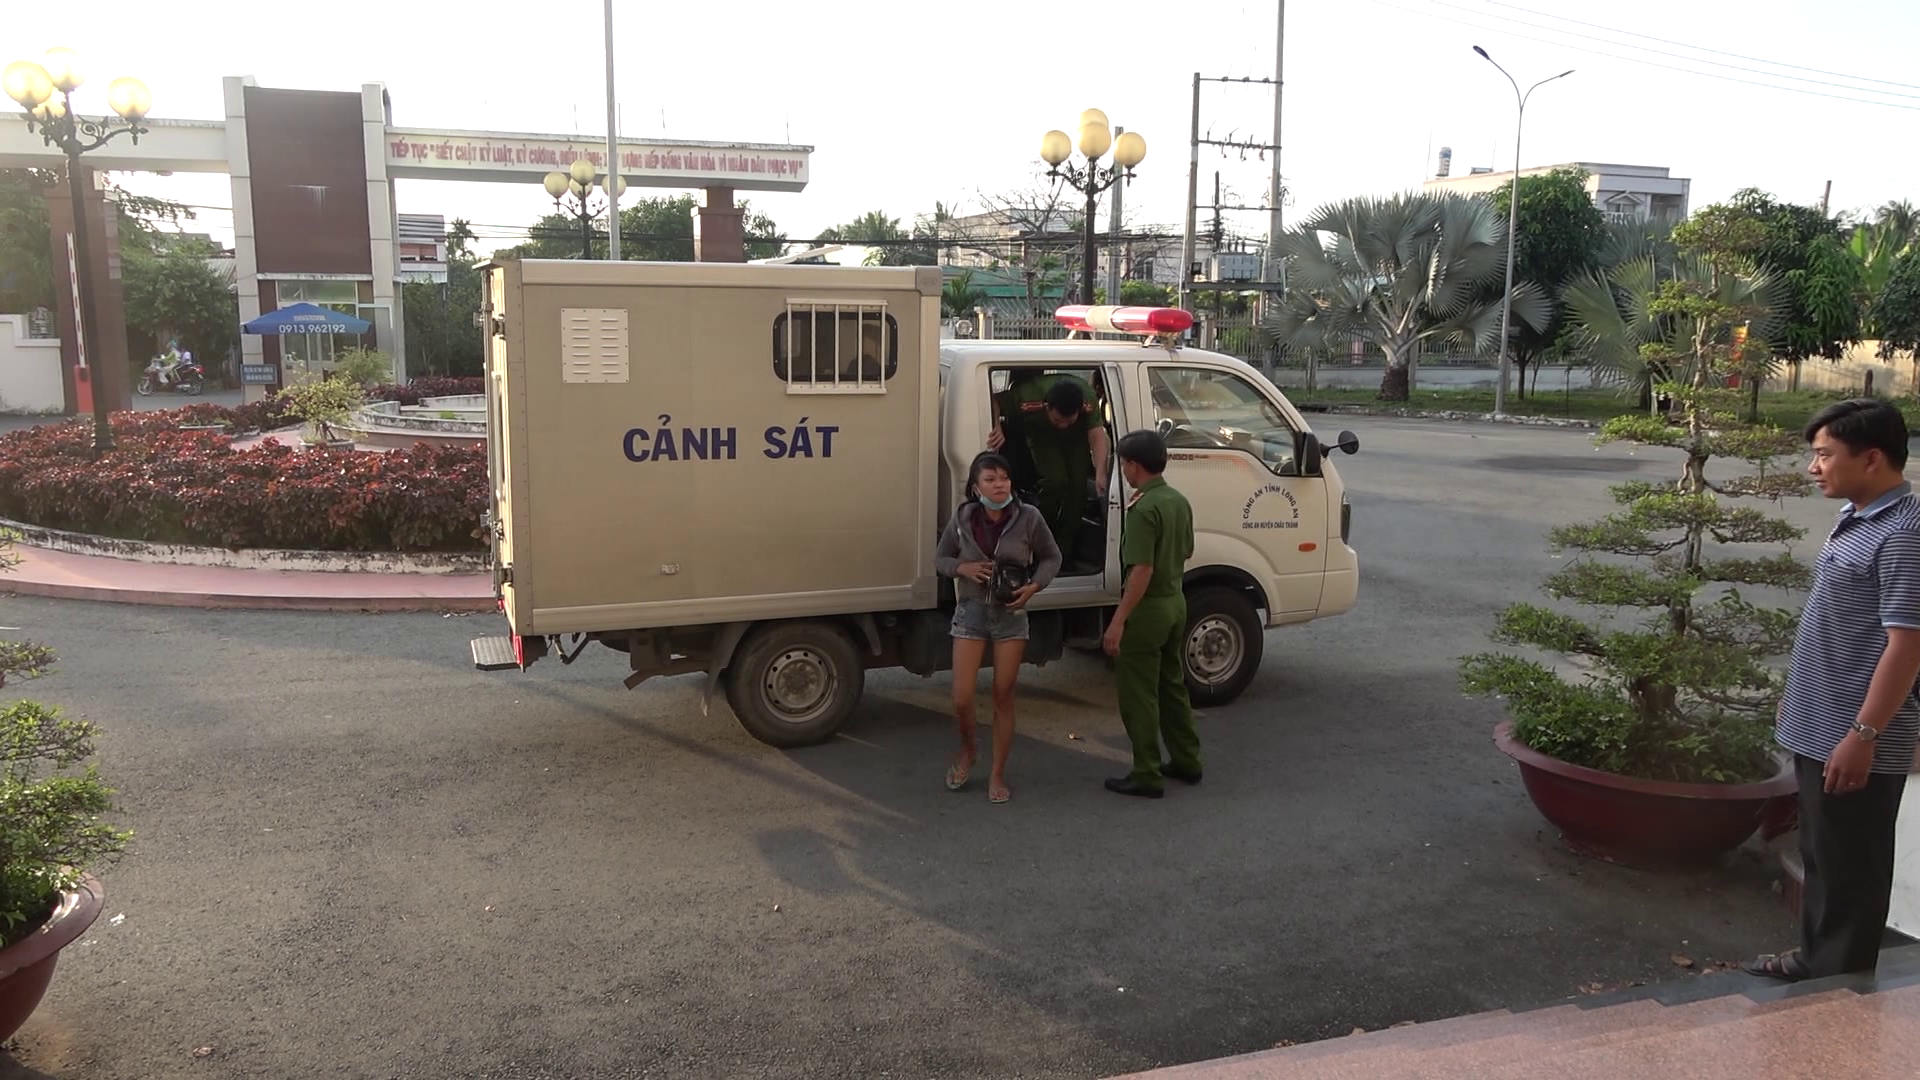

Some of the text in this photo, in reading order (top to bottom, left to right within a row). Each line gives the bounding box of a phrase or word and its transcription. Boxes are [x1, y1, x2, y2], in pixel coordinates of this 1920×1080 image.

[391, 137, 409, 158] TIẾP
[411, 144, 428, 163] TỤC
[455, 143, 477, 165] CHẬT
[683, 152, 699, 170] VĂN
[767, 159, 787, 178] PHỤC
[623, 414, 839, 462] CẢNH SÁT
[1242, 483, 1299, 519] CÔNG AN TỈNH LONG AN
[1242, 521, 1253, 529] CÔNG
[1260, 520, 1273, 530] HUYỆN
[1274, 520, 1284, 529] CHÂU
[1285, 521, 1298, 529] THÀNH
